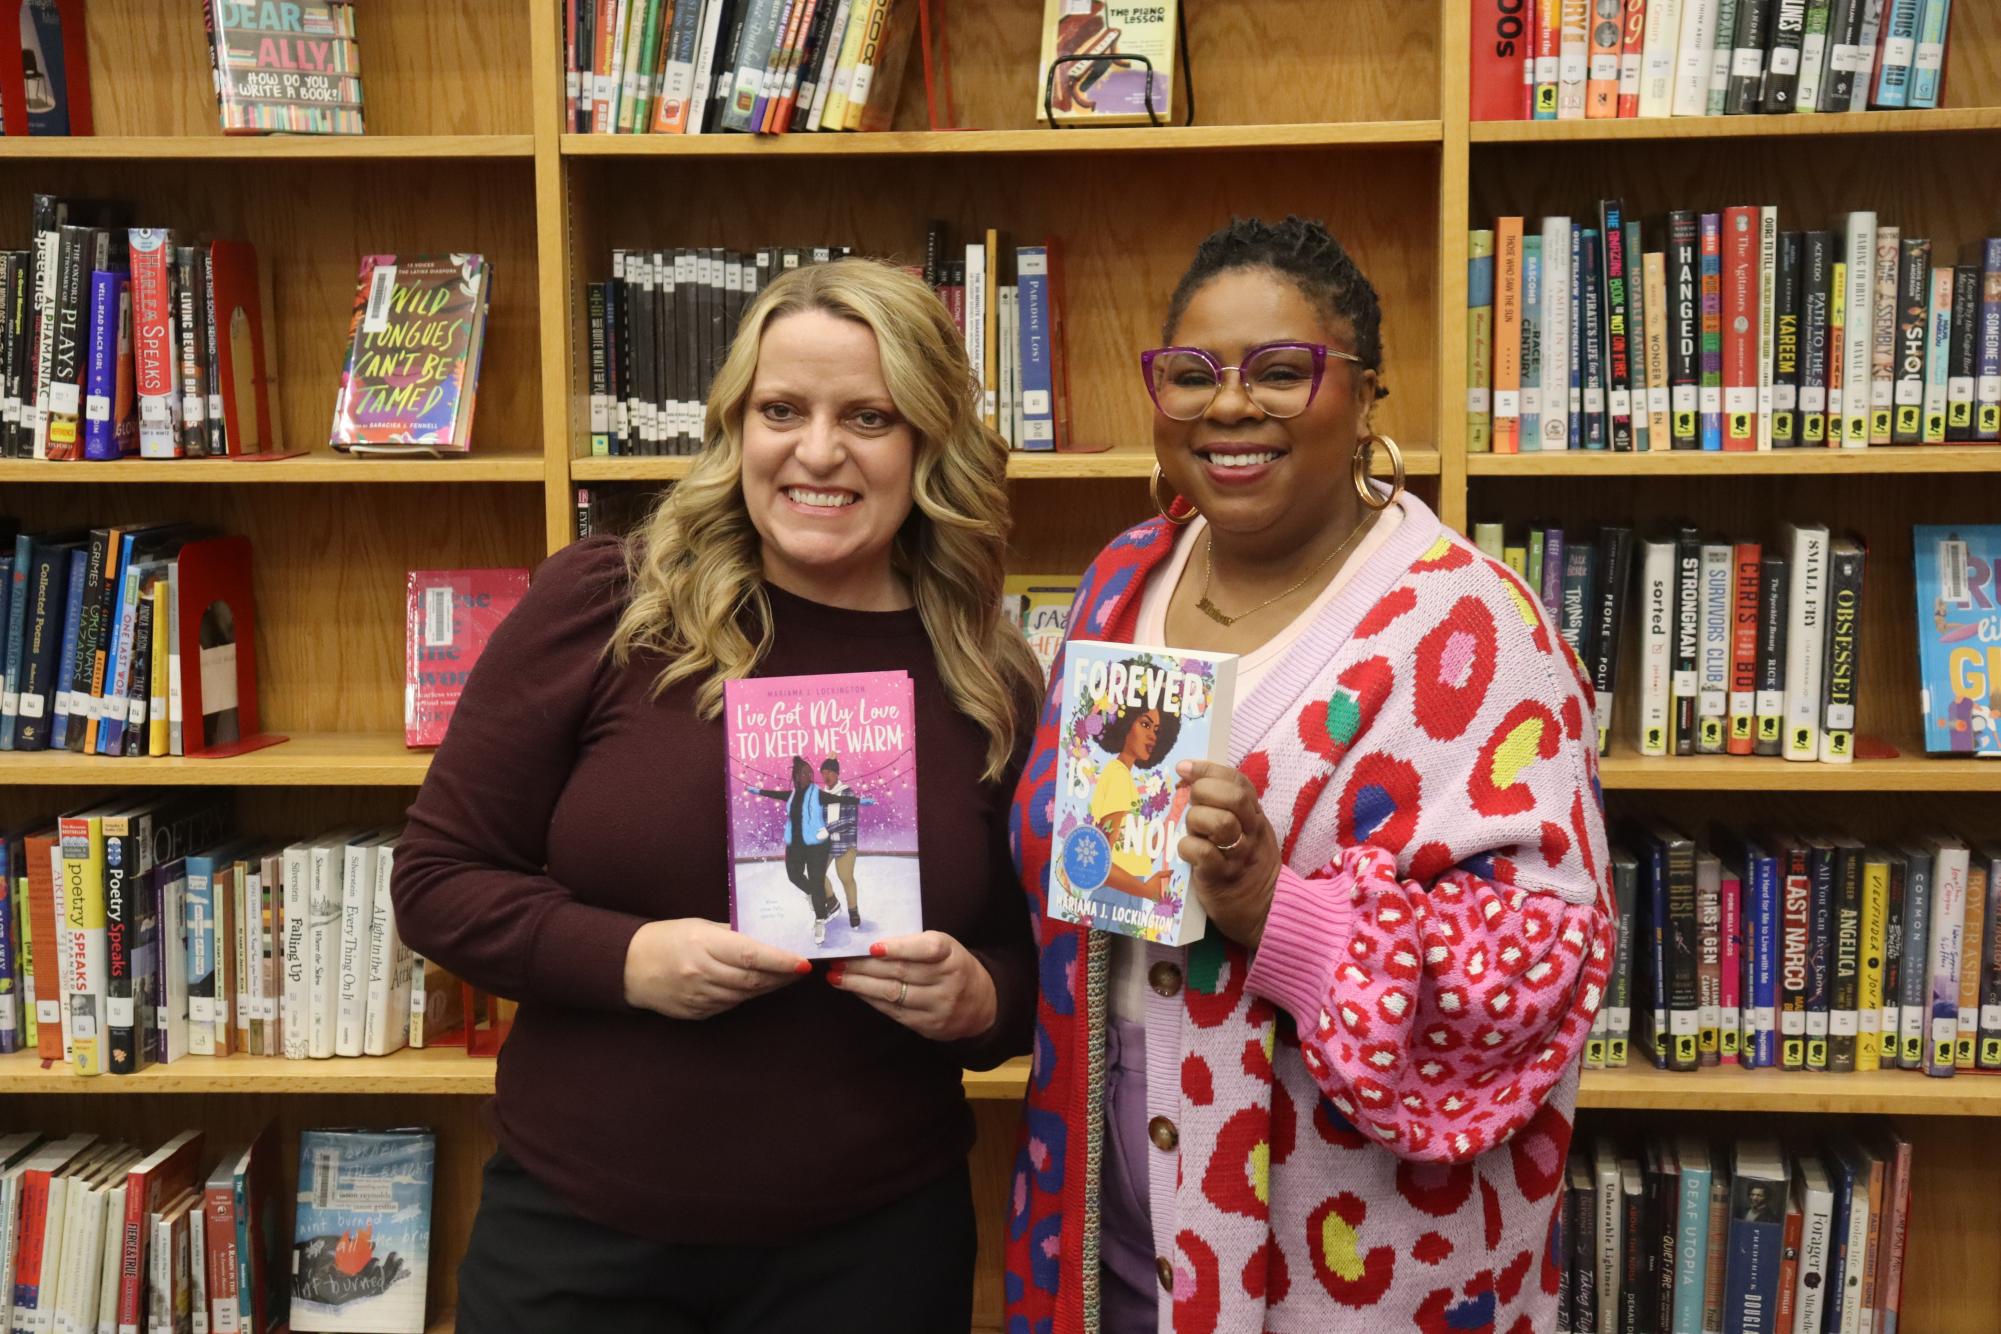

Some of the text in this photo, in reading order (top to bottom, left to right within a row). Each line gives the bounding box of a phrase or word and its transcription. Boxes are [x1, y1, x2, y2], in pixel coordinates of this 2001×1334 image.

[221, 0, 302, 32] DEAR
[257, 38, 334, 75] ALLY,
[1543, 40, 1552, 55] the
[239, 83, 338, 101] WRITE A BOOK?
[248, 72, 328, 88] HOW DO YOU
[1607, 210, 1620, 228] THE
[1504, 235, 1516, 322] THOSE WHO SAW THE SUN
[1527, 256, 1536, 304] BASCOMB
[1608, 230, 1622, 276] AMAZING
[1736, 235, 1749, 311] The Agitators
[1814, 241, 1822, 281] ACEVEDO
[139, 253, 160, 323] HARLEM
[205, 257, 216, 355] LEAVE THIS SONG BEHIND
[389, 280, 449, 316] WILD
[953, 290, 962, 321] MARLOWE
[1571, 231, 1580, 370] OUR FELLOW KENTUCKIANS
[1586, 293, 1599, 336] PIRATE'S
[1610, 279, 1624, 305] BOOK
[1679, 246, 1693, 373] HANGED!
[1873, 245, 1898, 356] SOME ASSEMBLY
[57, 308, 77, 378] PLAYS
[180, 291, 195, 374] LIVING BEYOND
[364, 319, 463, 351] TONGUES
[1029, 281, 1042, 363] PARADISE LOST
[1611, 315, 1625, 335] NOT
[1612, 336, 1626, 352] ON
[1631, 267, 1643, 371] NOTABLE NATIVE
[1778, 315, 1796, 373] KAREEM
[1812, 292, 1825, 374] PATH TO THE
[1935, 313, 1943, 347] ANGELOU
[1985, 313, 1997, 360] SOMEONE
[39, 296, 55, 399] ALPHAMANIAC
[142, 325, 165, 389] SPEAKS
[353, 350, 452, 384] CAN'T BE
[1520, 318, 1531, 378] CENTURY
[1531, 330, 1541, 365] RACE
[1587, 338, 1599, 360] LIFE
[1587, 362, 1599, 374] for
[1613, 354, 1627, 378] FIRE
[1651, 334, 1661, 380] WONDER
[356, 384, 444, 418] TAMED
[88, 541, 102, 587] GRIMES
[126, 576, 136, 603] GRIMES
[1803, 540, 1820, 630] SMALL FRY
[32, 563, 50, 654] Collected Poems
[1565, 586, 1584, 627] TRANS
[1651, 580, 1666, 635] sorted
[1680, 557, 1698, 658] STRONGMAN
[1739, 562, 1760, 624] CHRIS
[83, 604, 100, 685] ORDINARY
[136, 605, 149, 651] ANDREA GIBSON
[1706, 569, 1727, 683] SURVIVORS CLUB
[1832, 590, 1855, 706] OBSESSED
[767, 688, 804, 698] MARIAMA
[816, 686, 866, 697] LOCKINGTON
[1073, 658, 1205, 716] FOREVER
[1767, 658, 1776, 684] RICK
[736, 698, 899, 733] I've Got My Love
[736, 724, 903, 758] TO KEEP ME WARM
[1067, 756, 1091, 799] IS
[1669, 850, 1694, 920] THE RISE
[1847, 856, 1857, 879] MOLLY
[54, 870, 65, 923] ARIEL
[107, 868, 126, 977] Poetry Speaks
[288, 861, 303, 983] Silverstein Falling Up
[371, 854, 386, 974] Silverstein A Light in the
[1055, 893, 1174, 934] MARIAMA J. LOCKINGTON
[1784, 853, 1807, 991] THE LAST NARCO
[1912, 873, 1924, 942] COMMON
[68, 863, 87, 991] poetry SPEAKS
[1703, 893, 1719, 964] FIRST GEN
[1814, 864, 1830, 997] All You Can Ever Know
[1838, 909, 1857, 977] ANGELICA
[1868, 875, 1882, 997] VIEWFINDER JON
[1961, 875, 1982, 996] BOY ERASED
[67, 932, 76, 990] EXPANDED
[338, 1214, 382, 1227] burned
[1603, 1183, 1615, 1297] Unbearable Lightness
[1684, 1178, 1698, 1285] DEAF UTOPIA
[124, 1223, 138, 1279] FIERCE&TRUE
[1802, 1212, 1829, 1334] Forager Michelle
[326, 1271, 386, 1295] burned
[1575, 1269, 1593, 1306] Taking
[1627, 1293, 1636, 1324] DEMAR
